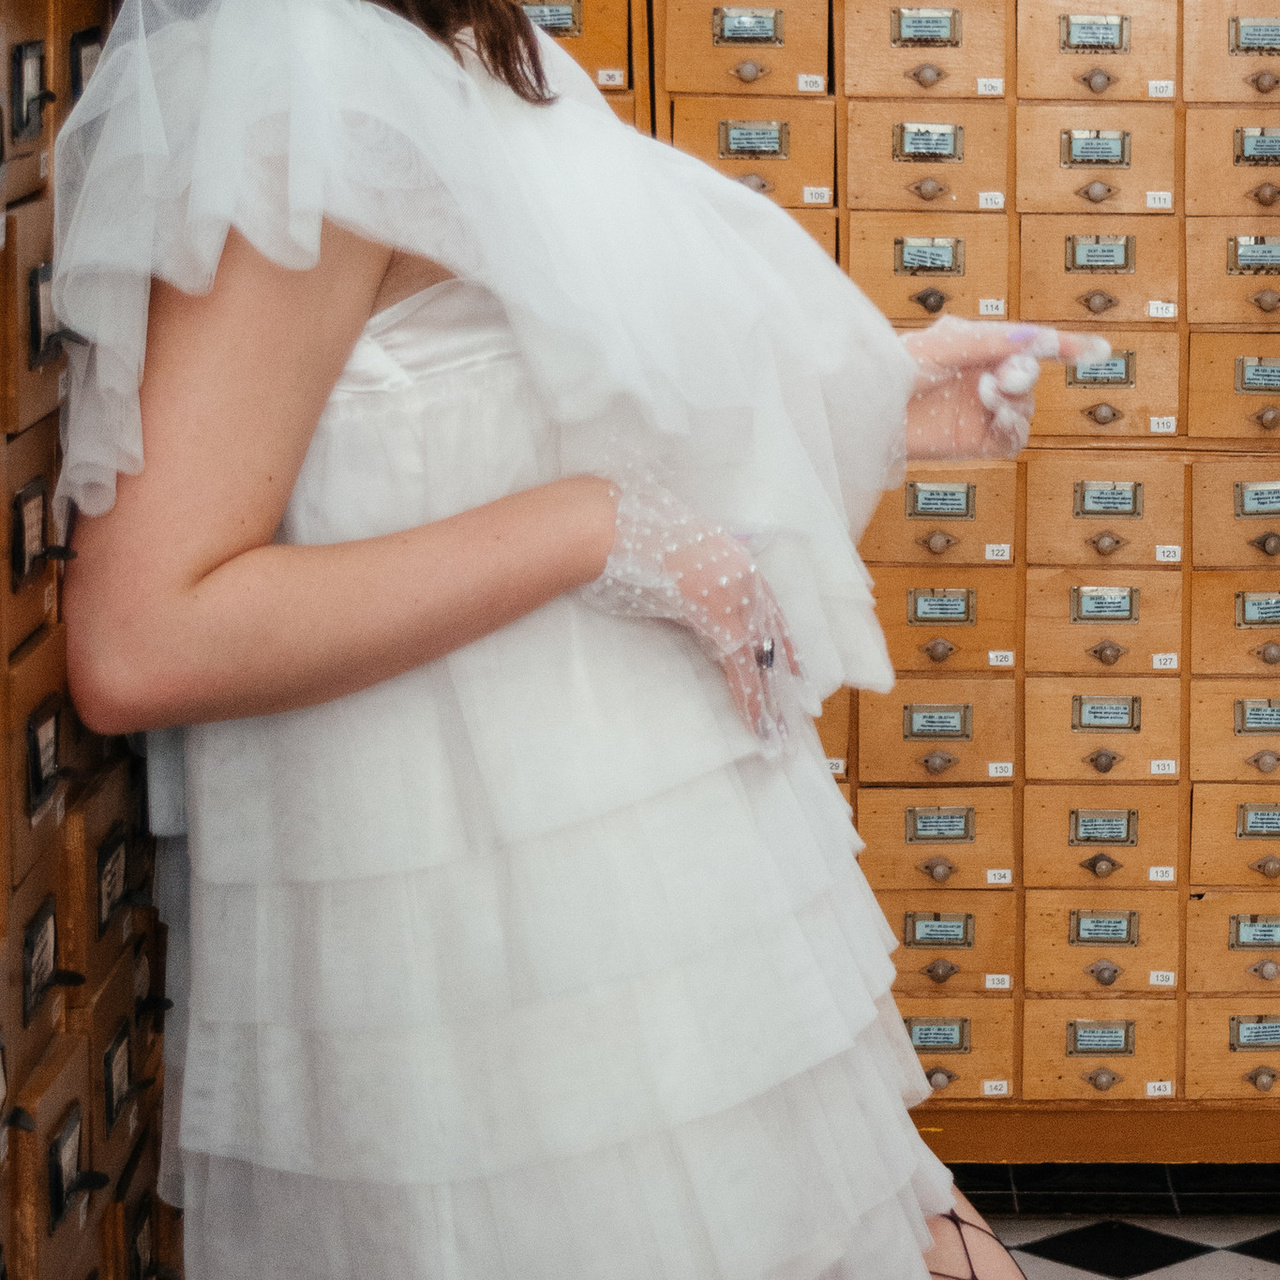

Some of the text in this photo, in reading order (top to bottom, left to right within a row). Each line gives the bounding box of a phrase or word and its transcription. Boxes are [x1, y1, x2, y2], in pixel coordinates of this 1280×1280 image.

[804, 79, 820, 89] 105
[1153, 84, 1170, 95] 107
[809, 191, 826, 201] 109
[1152, 196, 1168, 205] 111
[984, 304, 1000, 312] 114
[1155, 420, 1172, 430] 119
[990, 548, 1006, 558] 122
[1161, 549, 1177, 559] 123
[995, 654, 1010, 663] 126
[1158, 657, 1174, 666] 127
[994, 765, 1009, 774] 130
[1156, 762, 1171, 772] 131
[993, 872, 1007, 881] 134
[1155, 869, 1170, 878] 135
[991, 977, 1006, 986] 138
[1155, 974, 1171, 983] 139
[989, 1083, 1004, 1092] 142
[1152, 1084, 1168, 1092] 143
